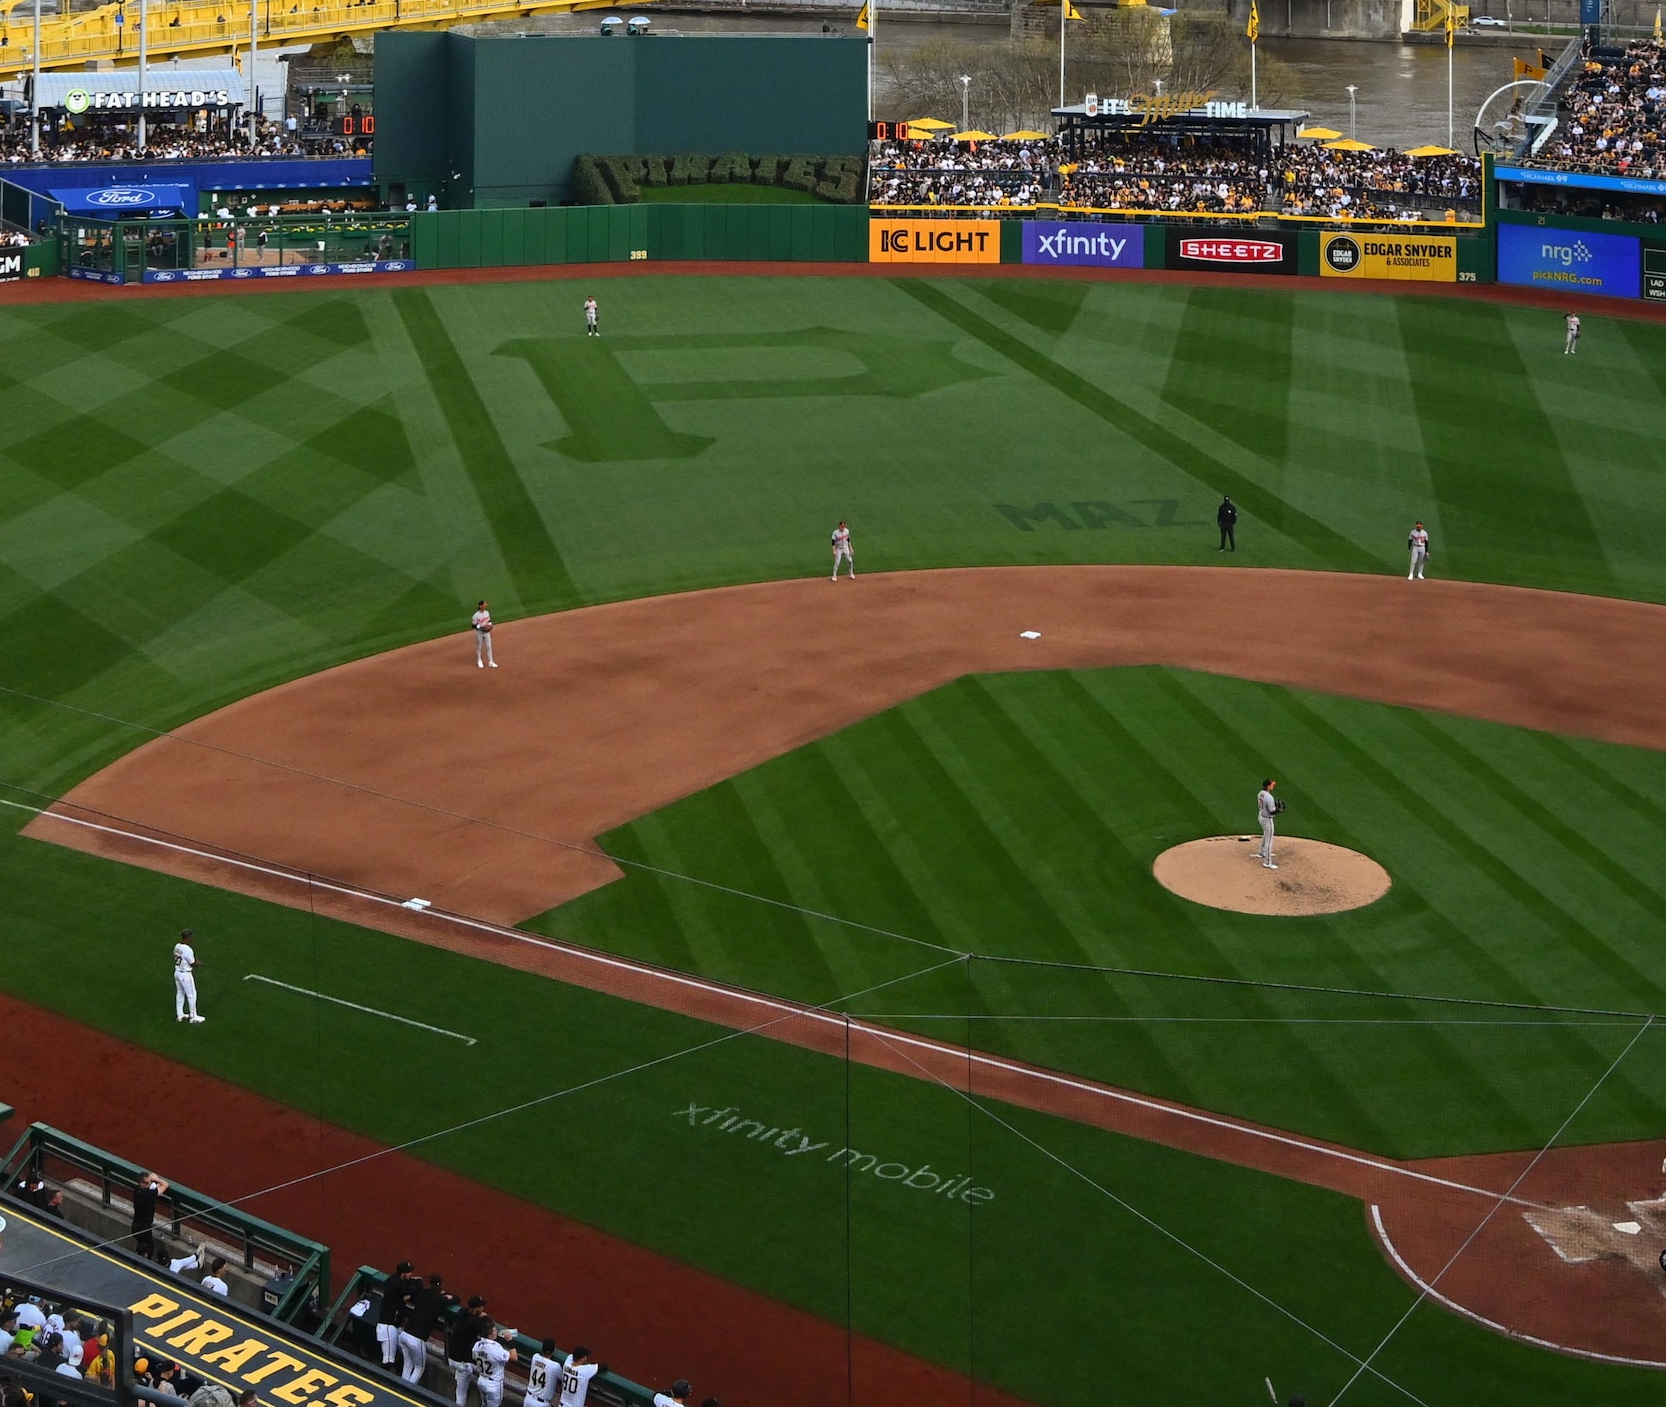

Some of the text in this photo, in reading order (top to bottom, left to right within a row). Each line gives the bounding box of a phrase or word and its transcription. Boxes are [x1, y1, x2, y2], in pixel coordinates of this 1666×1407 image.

[94, 90, 229, 108] FAT HEAD'S
[1103, 89, 1247, 127] IT'S Miller TIME
[876, 122, 910, 141] 0:10
[98, 189, 143, 204] Ford
[915, 231, 990, 252] LIGHT
[1038, 229, 1128, 261] xfinity
[1186, 242, 1276, 259] SHEETZ
[1364, 241, 1452, 259] EDGAR SNYDER
[630, 250, 648, 260] 399
[1332, 249, 1353, 259] EDGAR
[1332, 256, 1353, 265] SNYDER
[1386, 257, 1430, 268] & ASSOCIATES
[1541, 242, 1573, 266] nrg
[27, 267, 40, 277] 410
[1458, 271, 1476, 282] 375
[1533, 270, 1603, 287] pickNRG.com
[992, 499, 1210, 532] MAZ
[671, 1101, 996, 1205] xfinity mobile
[127, 1293, 375, 1407] PIRATES
